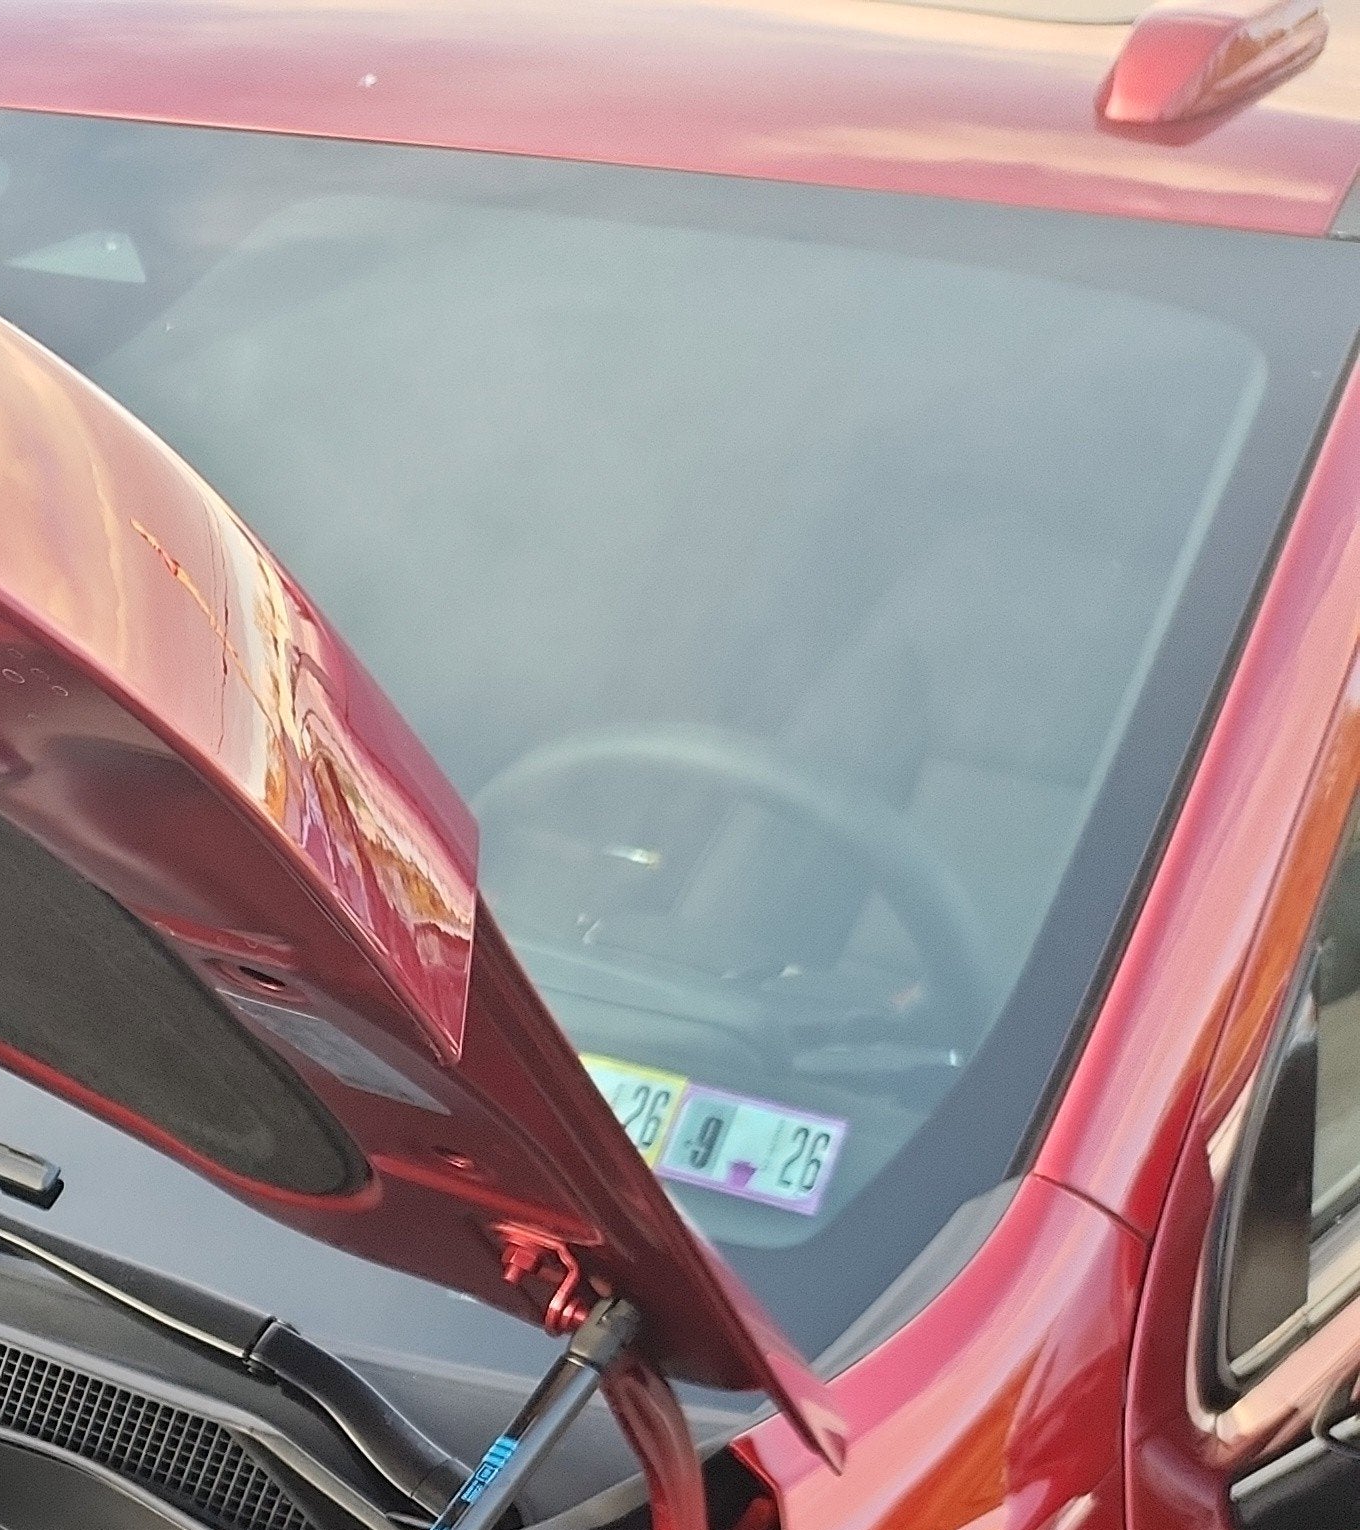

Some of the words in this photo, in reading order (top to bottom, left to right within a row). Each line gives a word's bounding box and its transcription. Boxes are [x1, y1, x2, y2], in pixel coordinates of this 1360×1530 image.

[623, 1085, 671, 1148] 26
[689, 1116, 724, 1170] 9
[777, 1126, 831, 1193] 26
